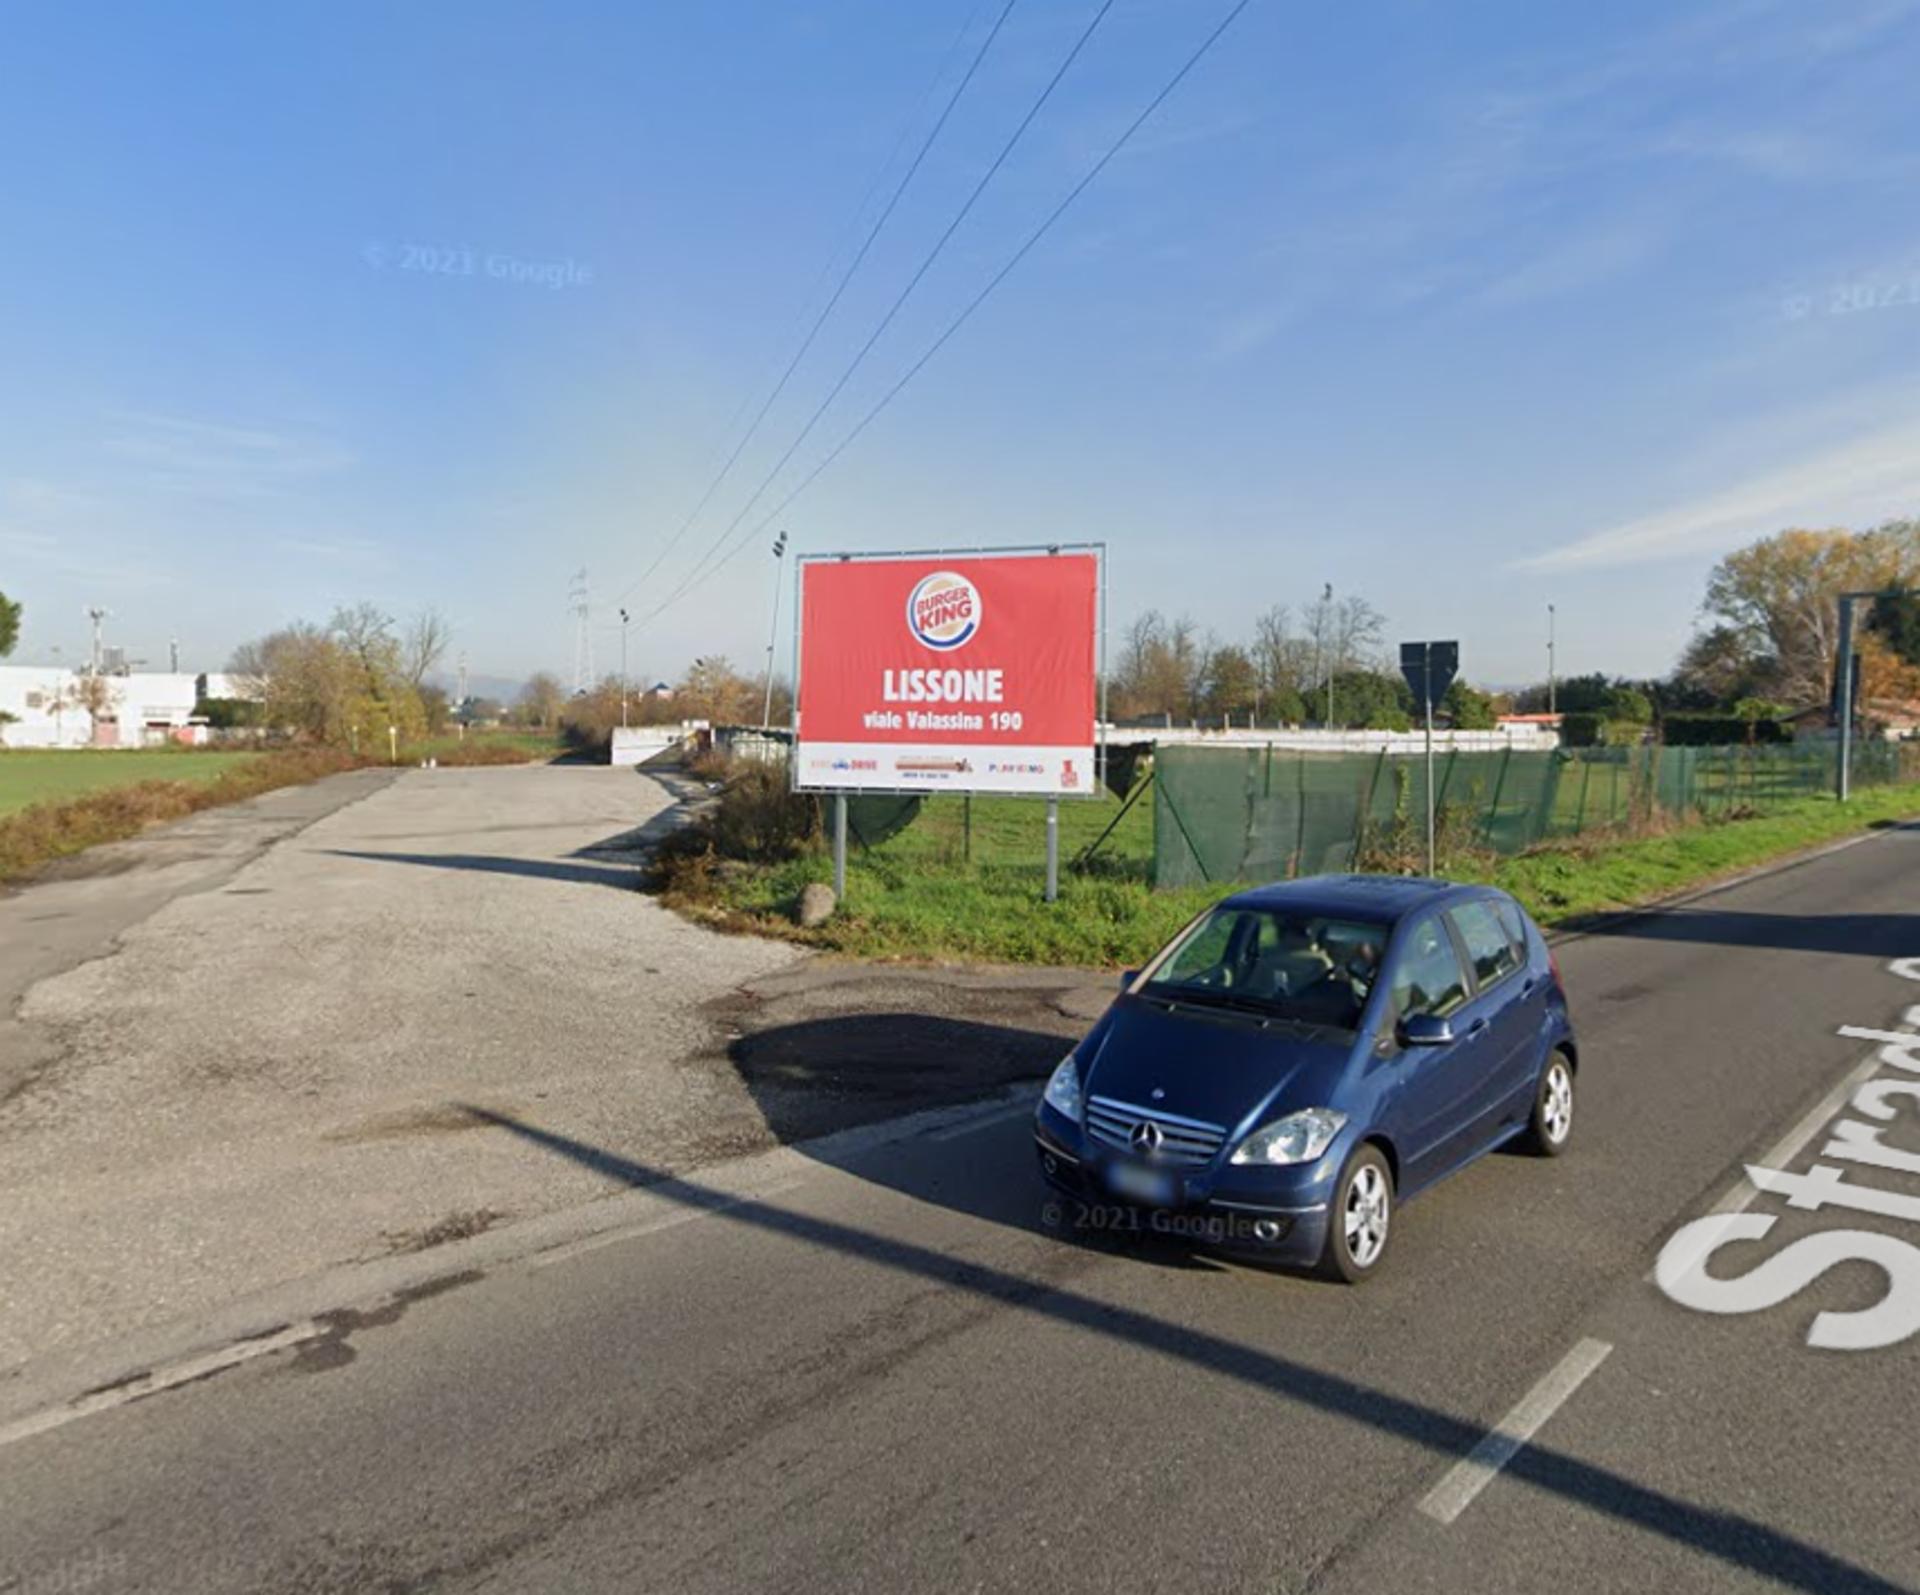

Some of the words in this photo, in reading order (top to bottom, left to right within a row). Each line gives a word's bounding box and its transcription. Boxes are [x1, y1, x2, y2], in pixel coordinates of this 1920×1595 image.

[917, 586, 970, 614] BURGER
[920, 600, 972, 631] KING
[884, 669, 1003, 702] LISSONE
[863, 711, 902, 729] viale
[906, 711, 983, 730] Valassina
[990, 712, 1022, 730] 190
